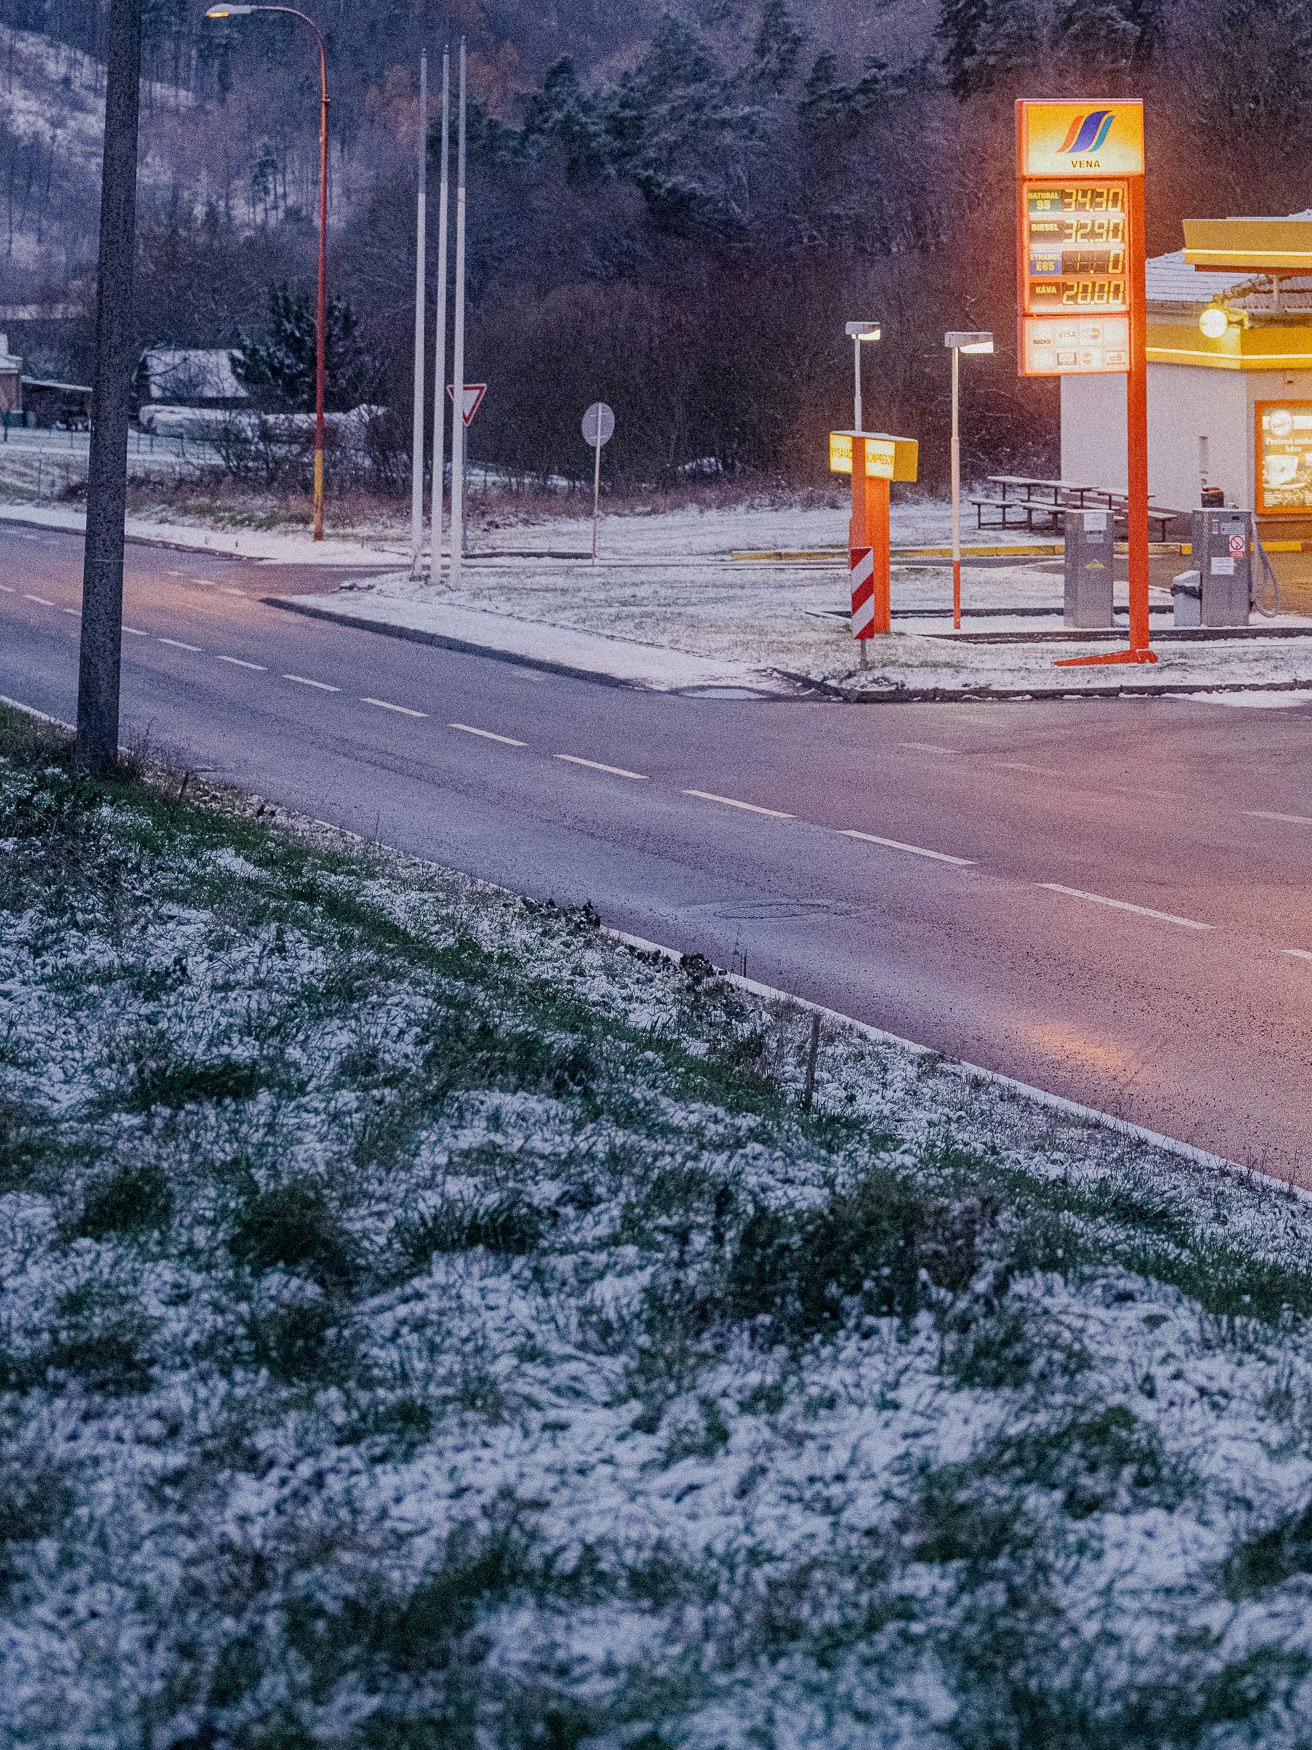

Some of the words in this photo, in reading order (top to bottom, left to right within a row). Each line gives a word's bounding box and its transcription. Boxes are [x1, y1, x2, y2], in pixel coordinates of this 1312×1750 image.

[1071, 160, 1100, 168] VENA
[1027, 192, 1059, 200] NATURAL
[1063, 188, 1123, 212] 34.30
[1036, 200, 1051, 210] 95
[1031, 223, 1059, 231] DIESEL
[1062, 219, 1123, 243] 32.90
[1036, 261, 1055, 271] E85
[1035, 284, 1057, 294] KÁVA
